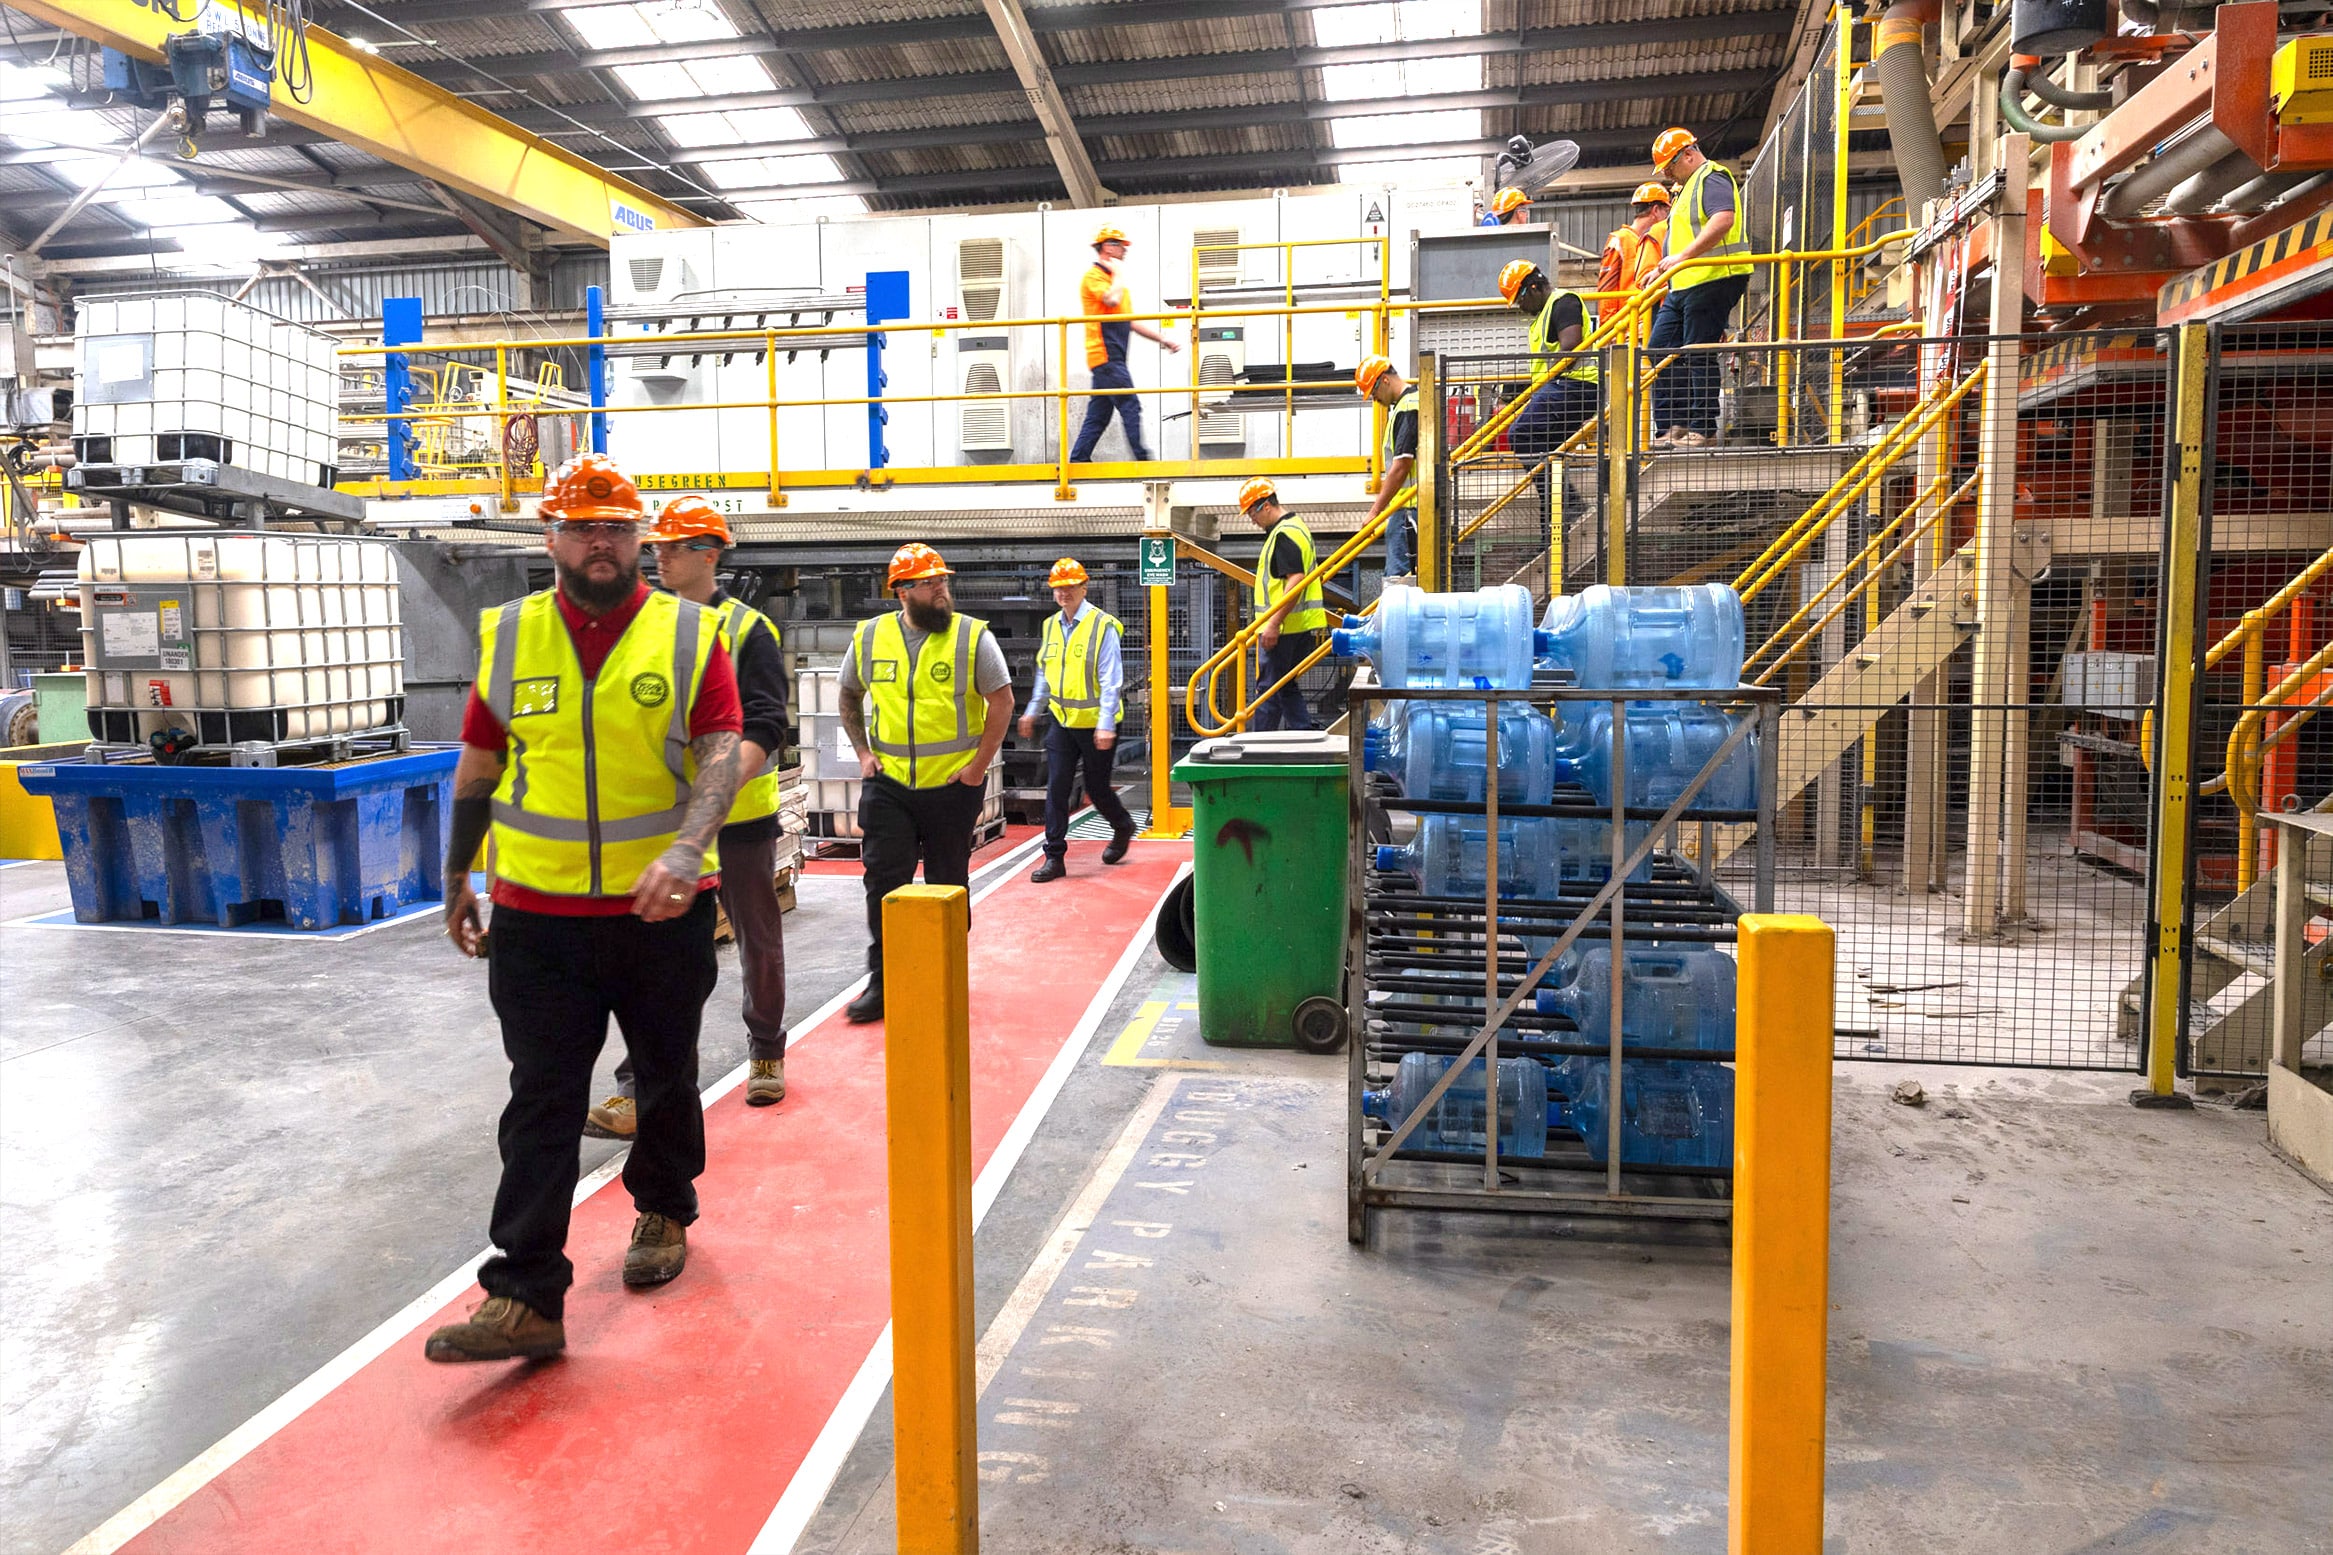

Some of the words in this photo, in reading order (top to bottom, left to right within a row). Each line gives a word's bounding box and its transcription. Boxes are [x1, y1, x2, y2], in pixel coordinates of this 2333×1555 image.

[615, 206, 653, 231] ABUS
[1134, 1091, 1237, 1195] BUGGY
[978, 1220, 1173, 1484] PARKING
